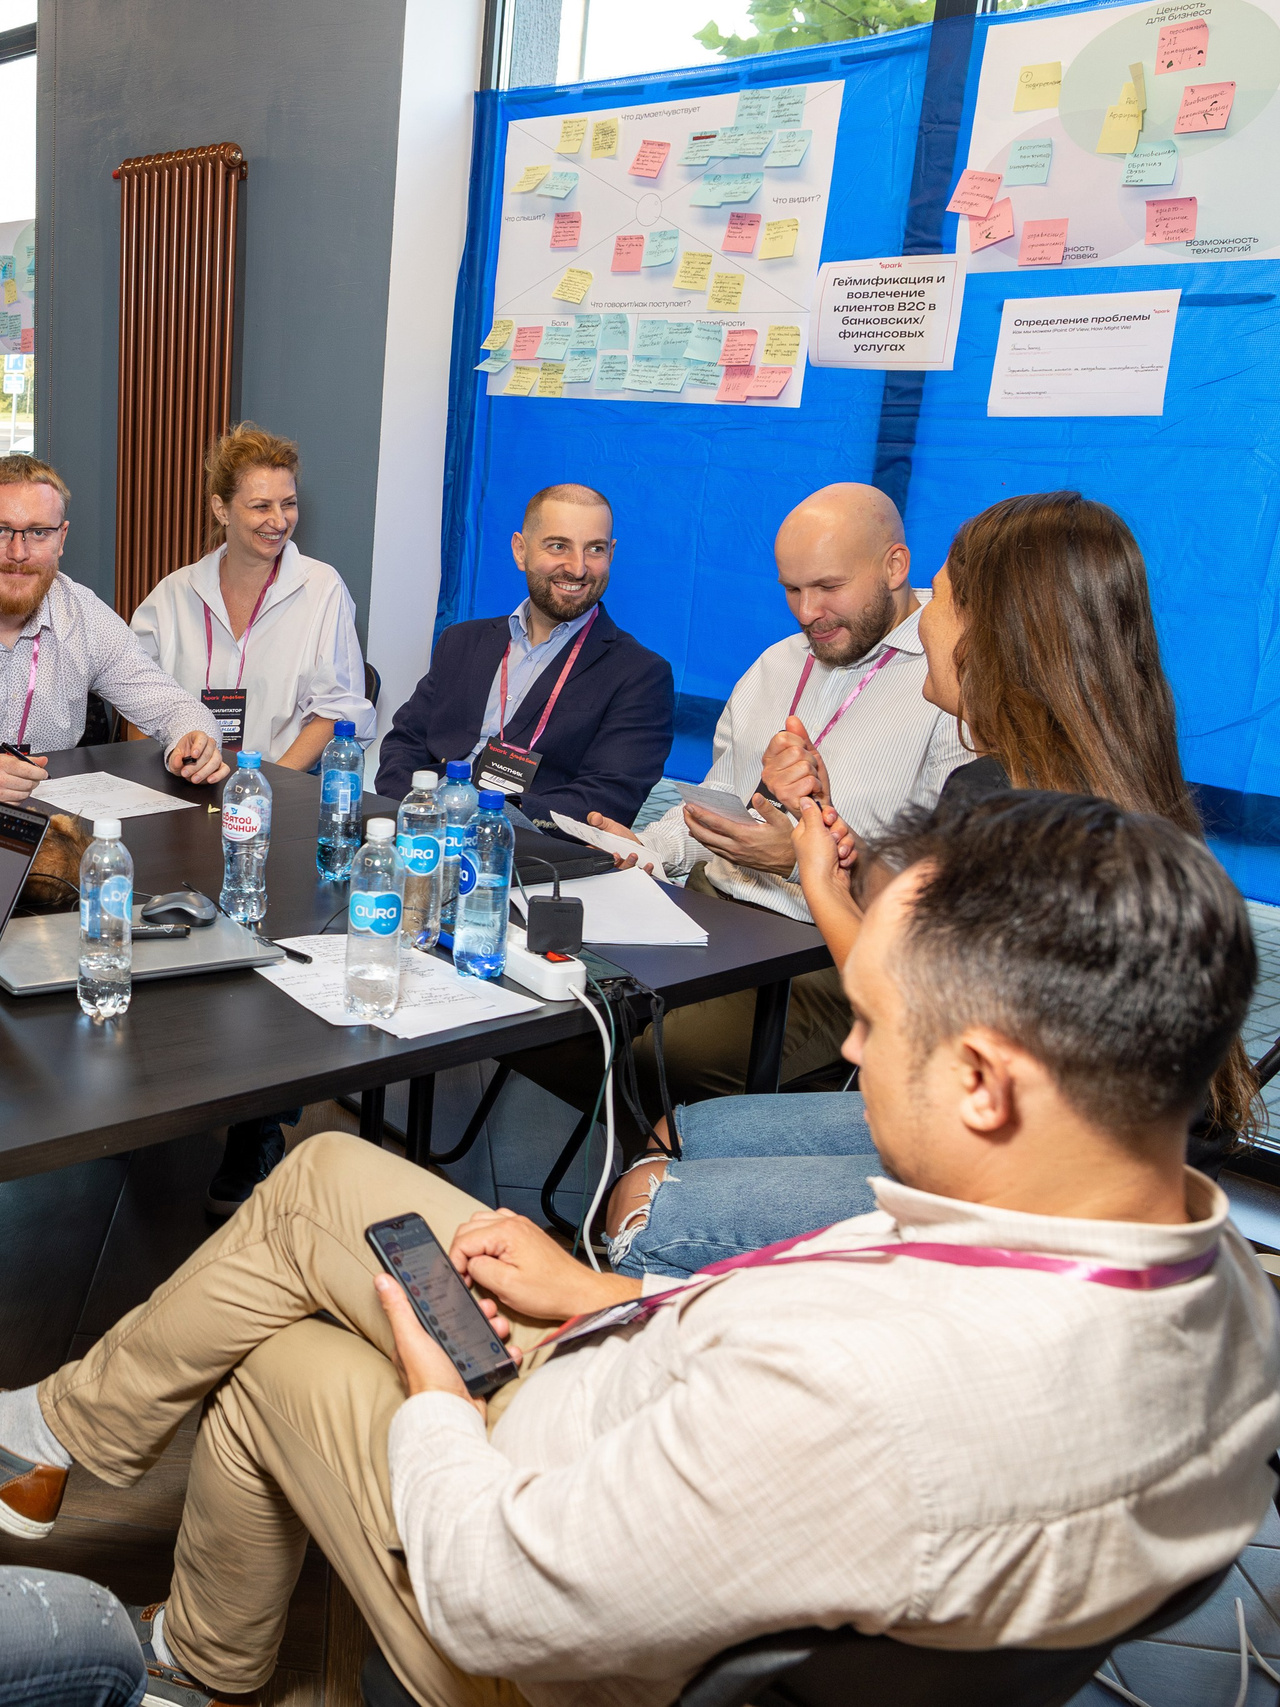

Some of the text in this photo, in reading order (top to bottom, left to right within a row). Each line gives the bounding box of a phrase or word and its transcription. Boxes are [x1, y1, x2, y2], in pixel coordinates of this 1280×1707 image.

[1156, 2, 1207, 16] Ценность
[1146, 8, 1212, 26] для бизнеса
[772, 194, 822, 204] Что видит?
[516, 214, 546, 222] слышит?
[1184, 236, 1259, 247] Возможность
[1191, 244, 1252, 254] технологий
[832, 275, 946, 287] Геймификация и
[846, 290, 926, 300] вовлечение
[604, 301, 648, 309] говорит/как
[648, 300, 692, 309] поступает?
[834, 302, 936, 312] клиентов B2C в
[842, 315, 925, 326] банковских/
[1014, 314, 1150, 327] Определение проблемы
[838, 329, 924, 340] финансовых
[854, 344, 906, 353] услугах
[491, 761, 523, 778] УЧАСТНИК
[398, 845, 434, 860] aura
[354, 904, 398, 920] aura
